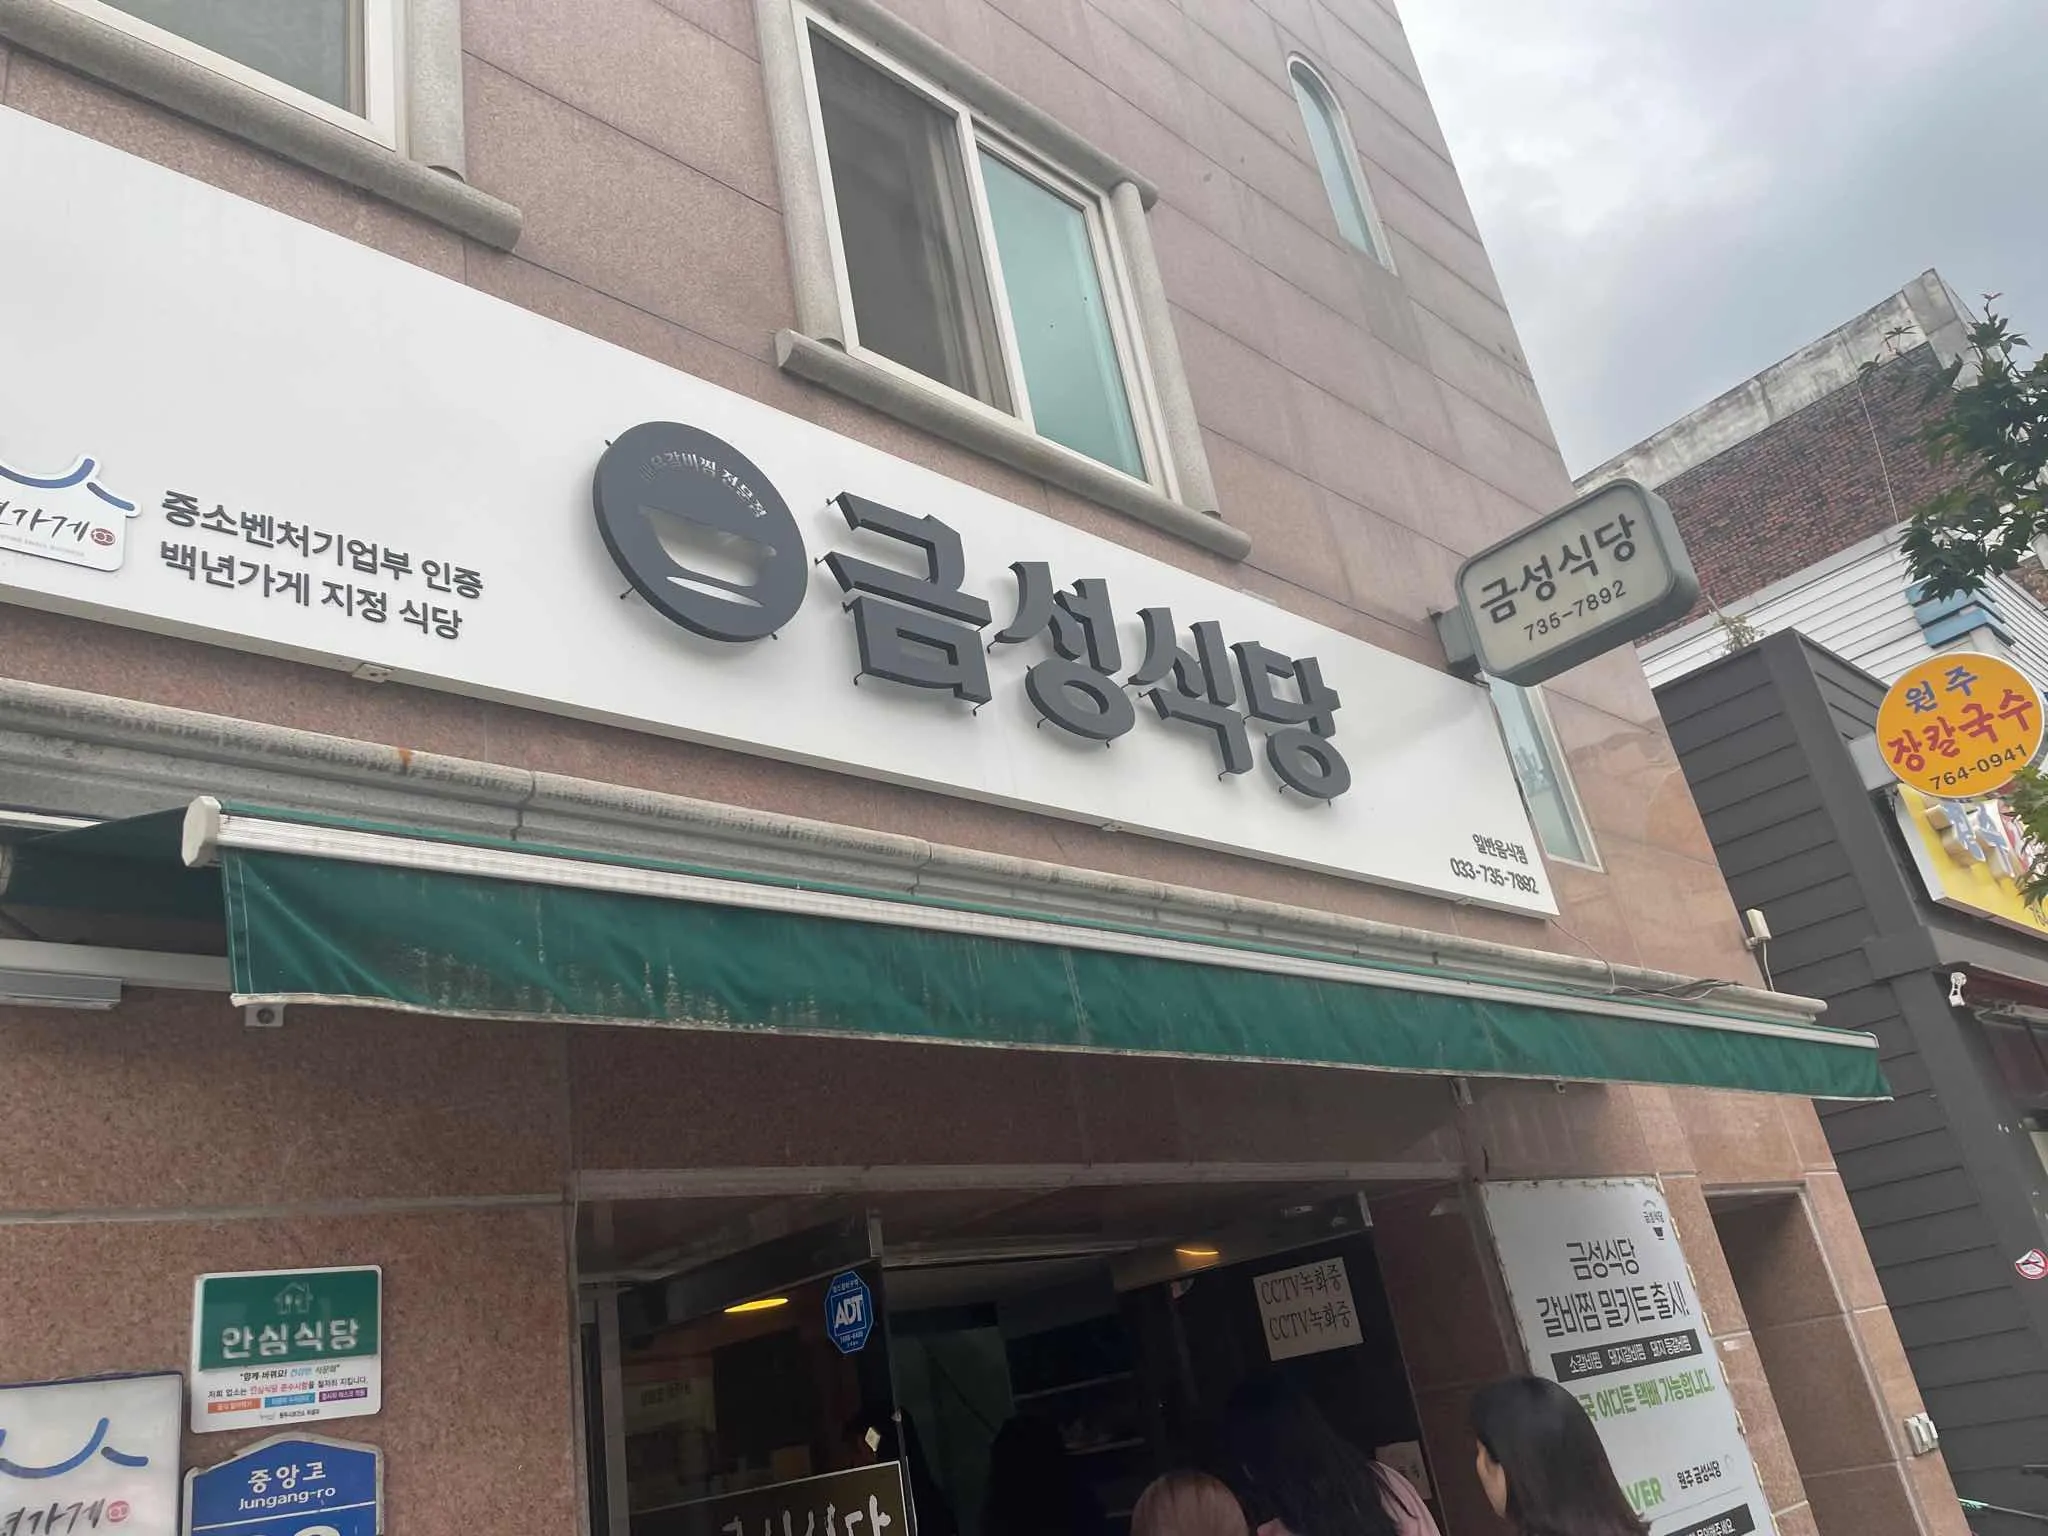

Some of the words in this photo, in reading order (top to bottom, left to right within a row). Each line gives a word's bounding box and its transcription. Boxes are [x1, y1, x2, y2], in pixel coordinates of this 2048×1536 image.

[162, 490, 412, 580] 중소벤처기업부
[422, 560, 484, 599] 인증
[161, 541, 309, 606] 백년가게
[321, 580, 387, 623] 지정
[399, 600, 463, 640] 식당
[1480, 513, 1636, 624] 금성식당
[1524, 580, 1626, 641] 735-7892
[823, 491, 1351, 799] 금성식당
[1905, 665, 1978, 714] 원주
[1887, 689, 2033, 773] 장칼국수
[1930, 743, 2028, 791] 764-0941
[1473, 833, 1528, 864] 일반음식점
[1450, 857, 1539, 894] 033-735-7892
[1566, 1238, 1640, 1280] 금성식당
[835, 1294, 864, 1328] ADT
[1536, 1291, 1602, 1337] 갈비찜
[1598, 1286, 1655, 1328] 밀키트
[1650, 1281, 1690, 1319] 출시!
[222, 1319, 360, 1359] 안심식당
[1577, 1394, 1599, 1422] 국
[1599, 1385, 1638, 1418] 어디든
[1635, 1378, 1663, 1408] 택배
[248, 1462, 327, 1493] 중앙로
[1626, 1477, 1665, 1511] VER
[1676, 1470, 1695, 1490] 원주
[1692, 1461, 1722, 1485] 금성식당
[239, 1486, 336, 1511] Jungang-ro
